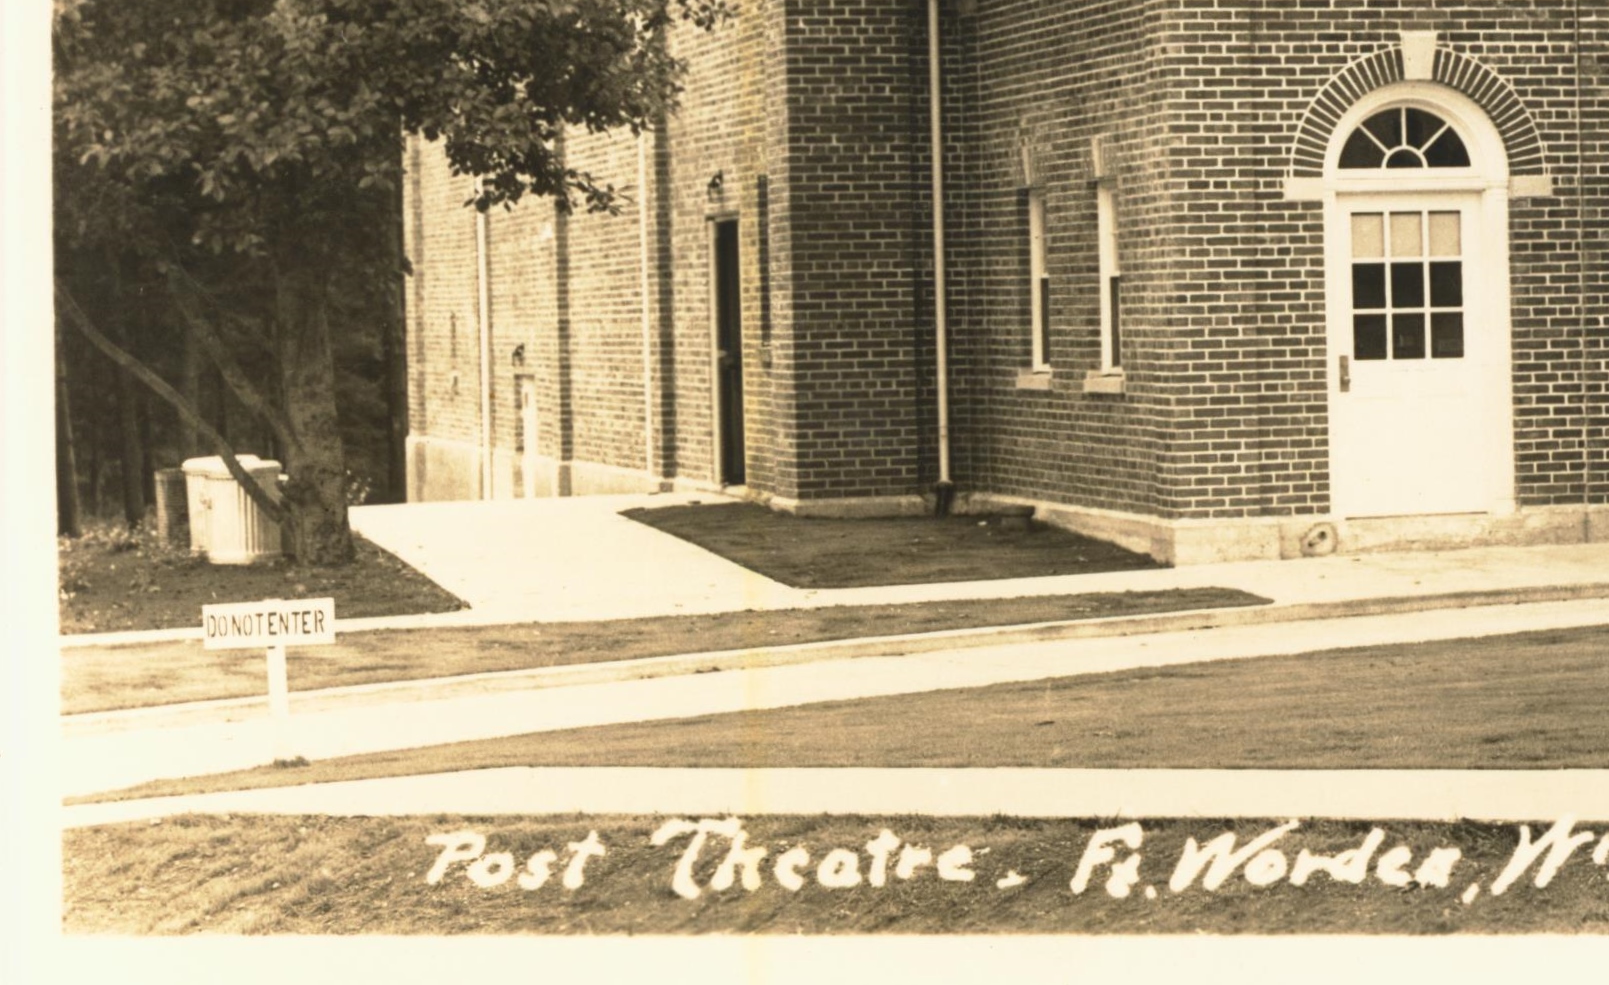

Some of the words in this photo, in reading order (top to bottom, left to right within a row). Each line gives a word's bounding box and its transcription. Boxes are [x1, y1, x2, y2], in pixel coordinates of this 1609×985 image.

[206, 615, 228, 638] DO
[231, 613, 263, 637] NOT
[267, 610, 325, 636] ENTER
